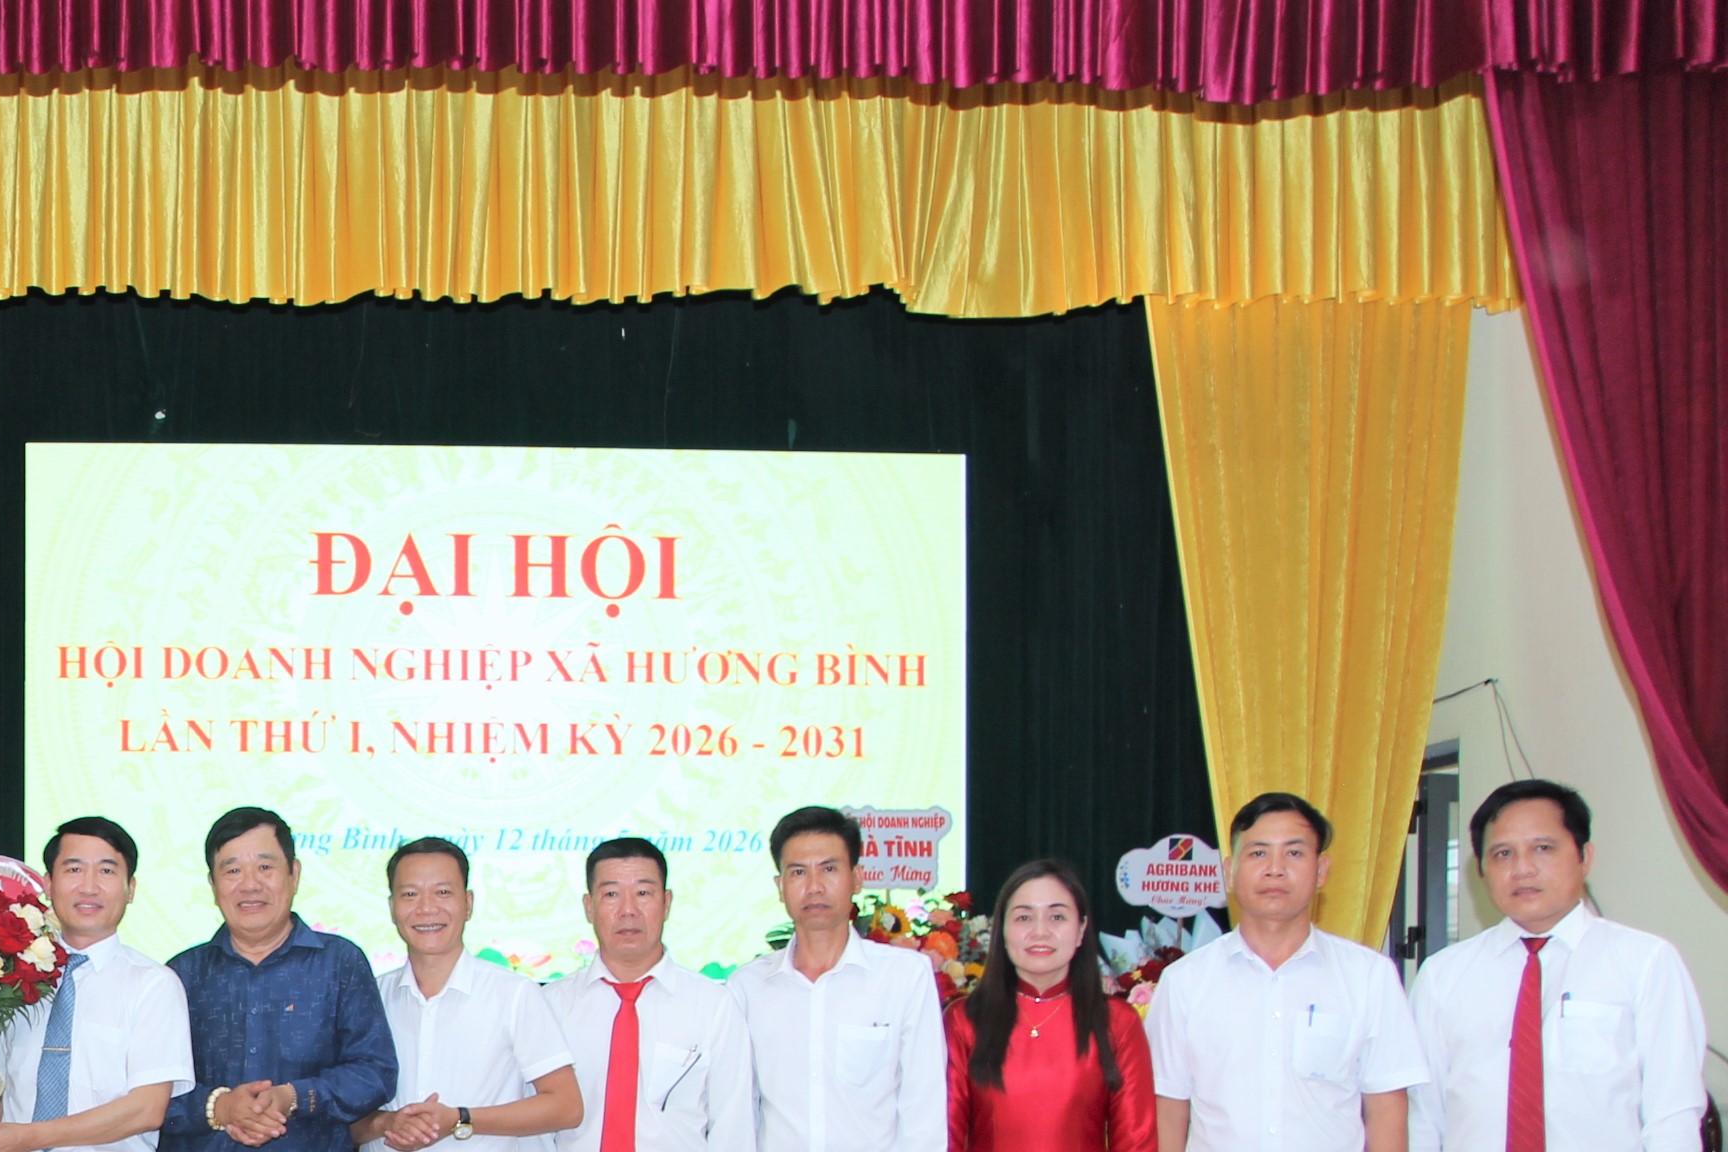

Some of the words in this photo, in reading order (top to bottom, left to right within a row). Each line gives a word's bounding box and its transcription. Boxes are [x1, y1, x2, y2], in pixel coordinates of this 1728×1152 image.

[309, 532, 478, 615] ĐẠI
[507, 524, 683, 618] HỘI
[57, 641, 144, 688] HỘI
[161, 646, 334, 681] DOANH
[351, 644, 533, 691] NGHIỆP
[546, 642, 609, 683] XÃ
[626, 646, 799, 686] HƯƠNG
[816, 643, 927, 688] BÌNH
[119, 709, 214, 752] LẦN
[230, 711, 337, 753] THỨ
[349, 721, 375, 760] I,
[390, 717, 549, 763] NHIỆM
[568, 714, 633, 755] KỲ
[649, 724, 738, 757] 2026
[780, 725, 865, 758] 2031
[859, 813, 875, 831] HỘI
[878, 816, 909, 828] DOANH
[912, 813, 945, 832] NGHIỆP
[496, 828, 523, 850] 12
[703, 830, 763, 852] 2026
[883, 835, 932, 857] TĨNH
[890, 864, 932, 886] Mừng
[1146, 863, 1218, 877] AGRIBANK
[1141, 880, 1190, 892] HƯƠNG
[1193, 880, 1221, 894] KHÊ
